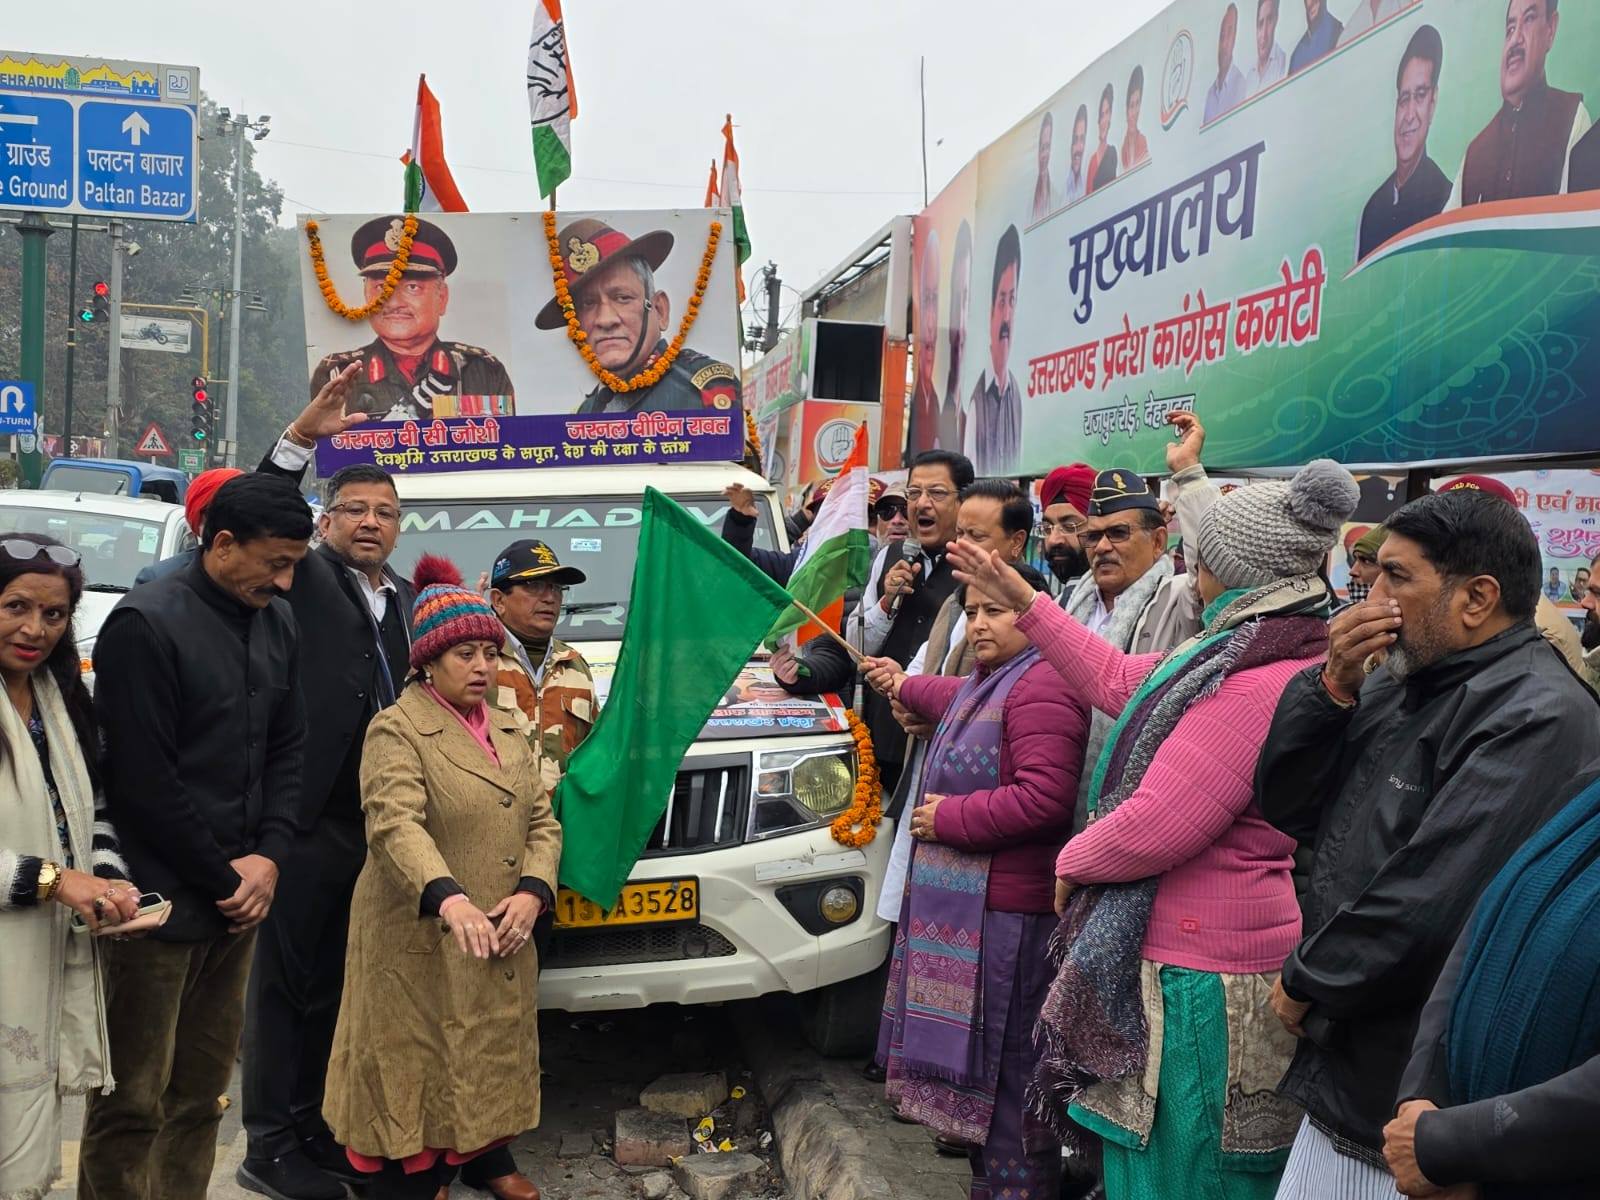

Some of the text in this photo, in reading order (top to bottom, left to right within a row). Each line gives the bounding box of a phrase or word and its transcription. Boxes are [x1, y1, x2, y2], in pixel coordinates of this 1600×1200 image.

[0, 74, 64, 89] EHRADUN
[6, 137, 51, 167] ग्राउंड
[87, 149, 184, 177] पलटन बाजार
[9, 175, 67, 200] Ground
[85, 181, 185, 208] Paltan Bazar
[1069, 140, 1266, 325] मुख्यालय
[1027, 247, 1326, 398] उत्तराखण्ड प्रदेश कांग्रेस कमेटी
[398, 419, 420, 447] बी
[422, 419, 448, 446] सी
[450, 418, 501, 445] जोशी
[631, 411, 685, 438] बीपिन
[687, 416, 731, 436] रावत
[374, 448, 424, 470] देवभूमि
[430, 447, 498, 463] उत्तराखण्ड
[501, 444, 516, 460] के
[562, 441, 586, 459] देश
[589, 439, 608, 457] की
[612, 443, 639, 457] रक्षा
[642, 439, 656, 455] के
[1536, 489, 1572, 511] एवं
[400, 508, 732, 533] MAHADV
